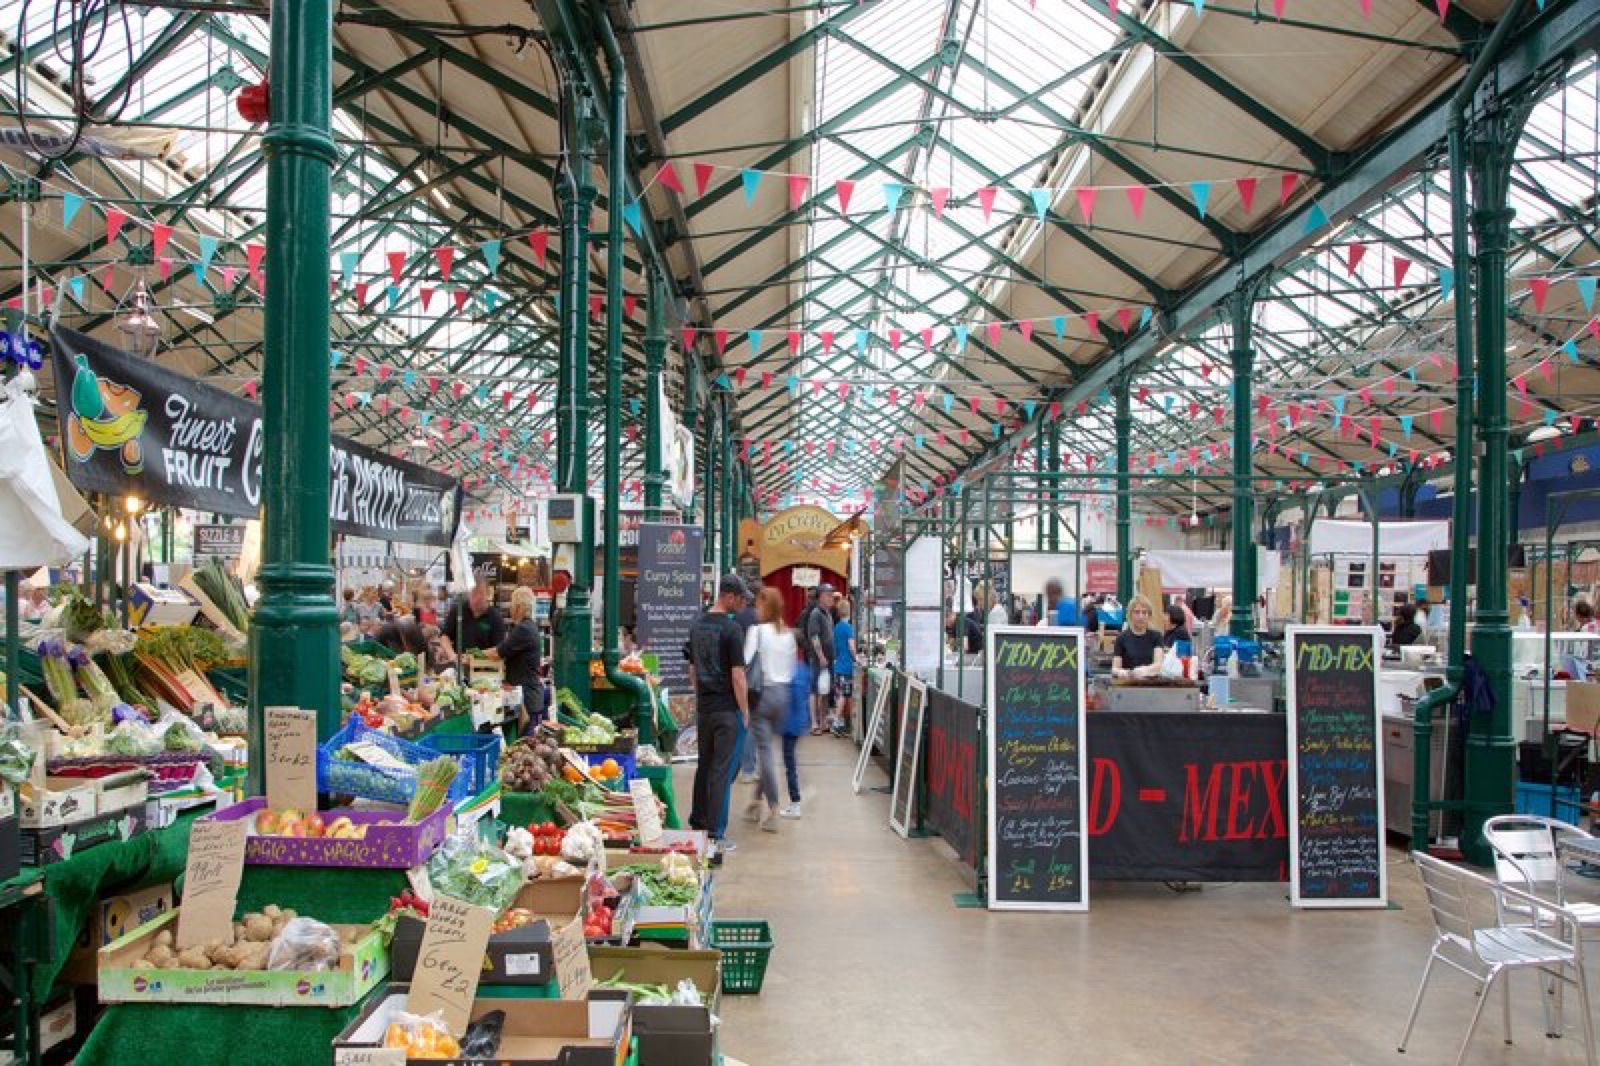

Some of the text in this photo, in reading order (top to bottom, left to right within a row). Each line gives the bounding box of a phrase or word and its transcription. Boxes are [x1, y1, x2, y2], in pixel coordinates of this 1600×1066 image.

[165, 393, 237, 455] Finest
[351, 453, 404, 531] PATCH
[643, 569, 698, 585] Curry Spice
[657, 585, 685, 597] Packs
[1178, 759, 1288, 843] MEX
[323, 841, 370, 863] MAGIC
